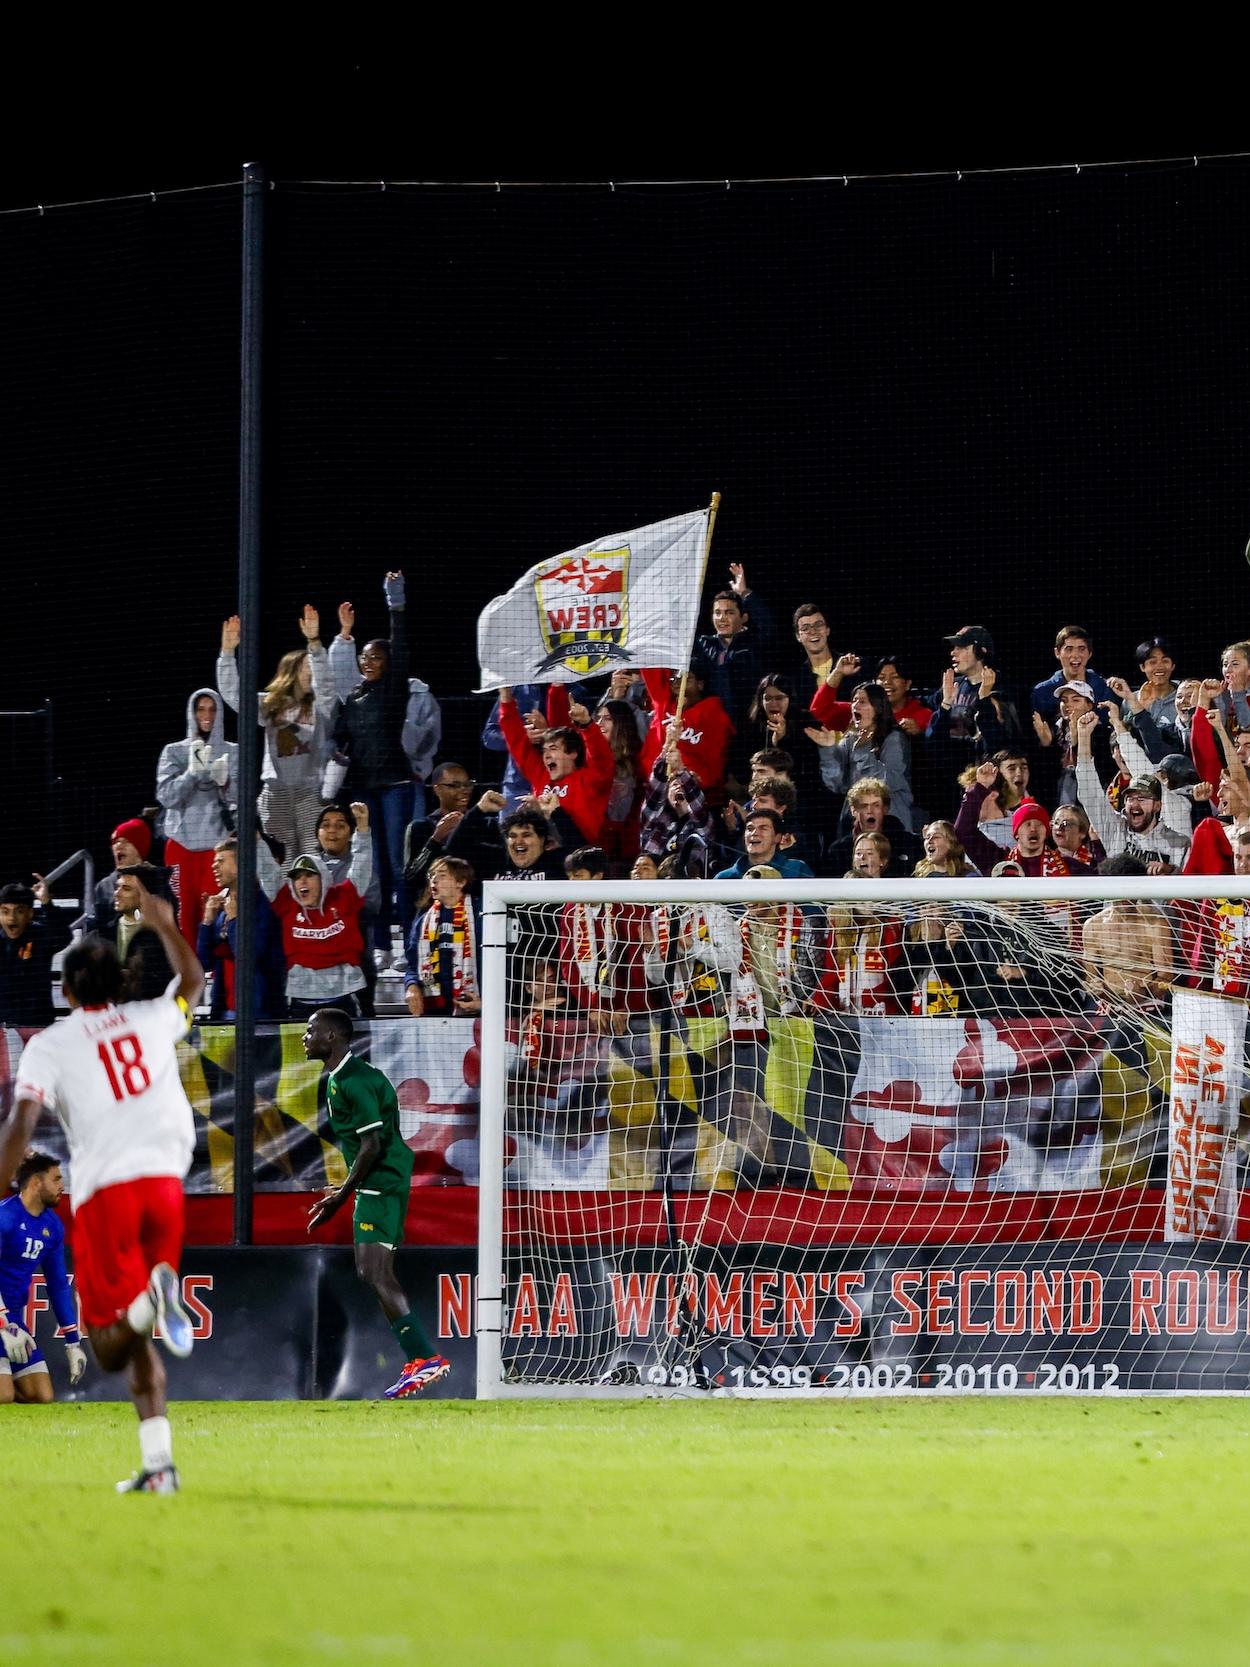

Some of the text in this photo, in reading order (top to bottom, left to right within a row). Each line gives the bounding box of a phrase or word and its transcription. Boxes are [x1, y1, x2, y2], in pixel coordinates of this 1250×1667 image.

[294, 923, 344, 938] MARYLAND
[97, 1032, 151, 1101] 18
[438, 1272, 578, 1338] NAA
[607, 1271, 866, 1338] WOMEN'S
[890, 1269, 1102, 1336] SECOND
[730, 1364, 812, 1389] 1999
[833, 1364, 913, 1390] 2002
[936, 1363, 1018, 1391] 2010
[1041, 1363, 1120, 1391] 2012
